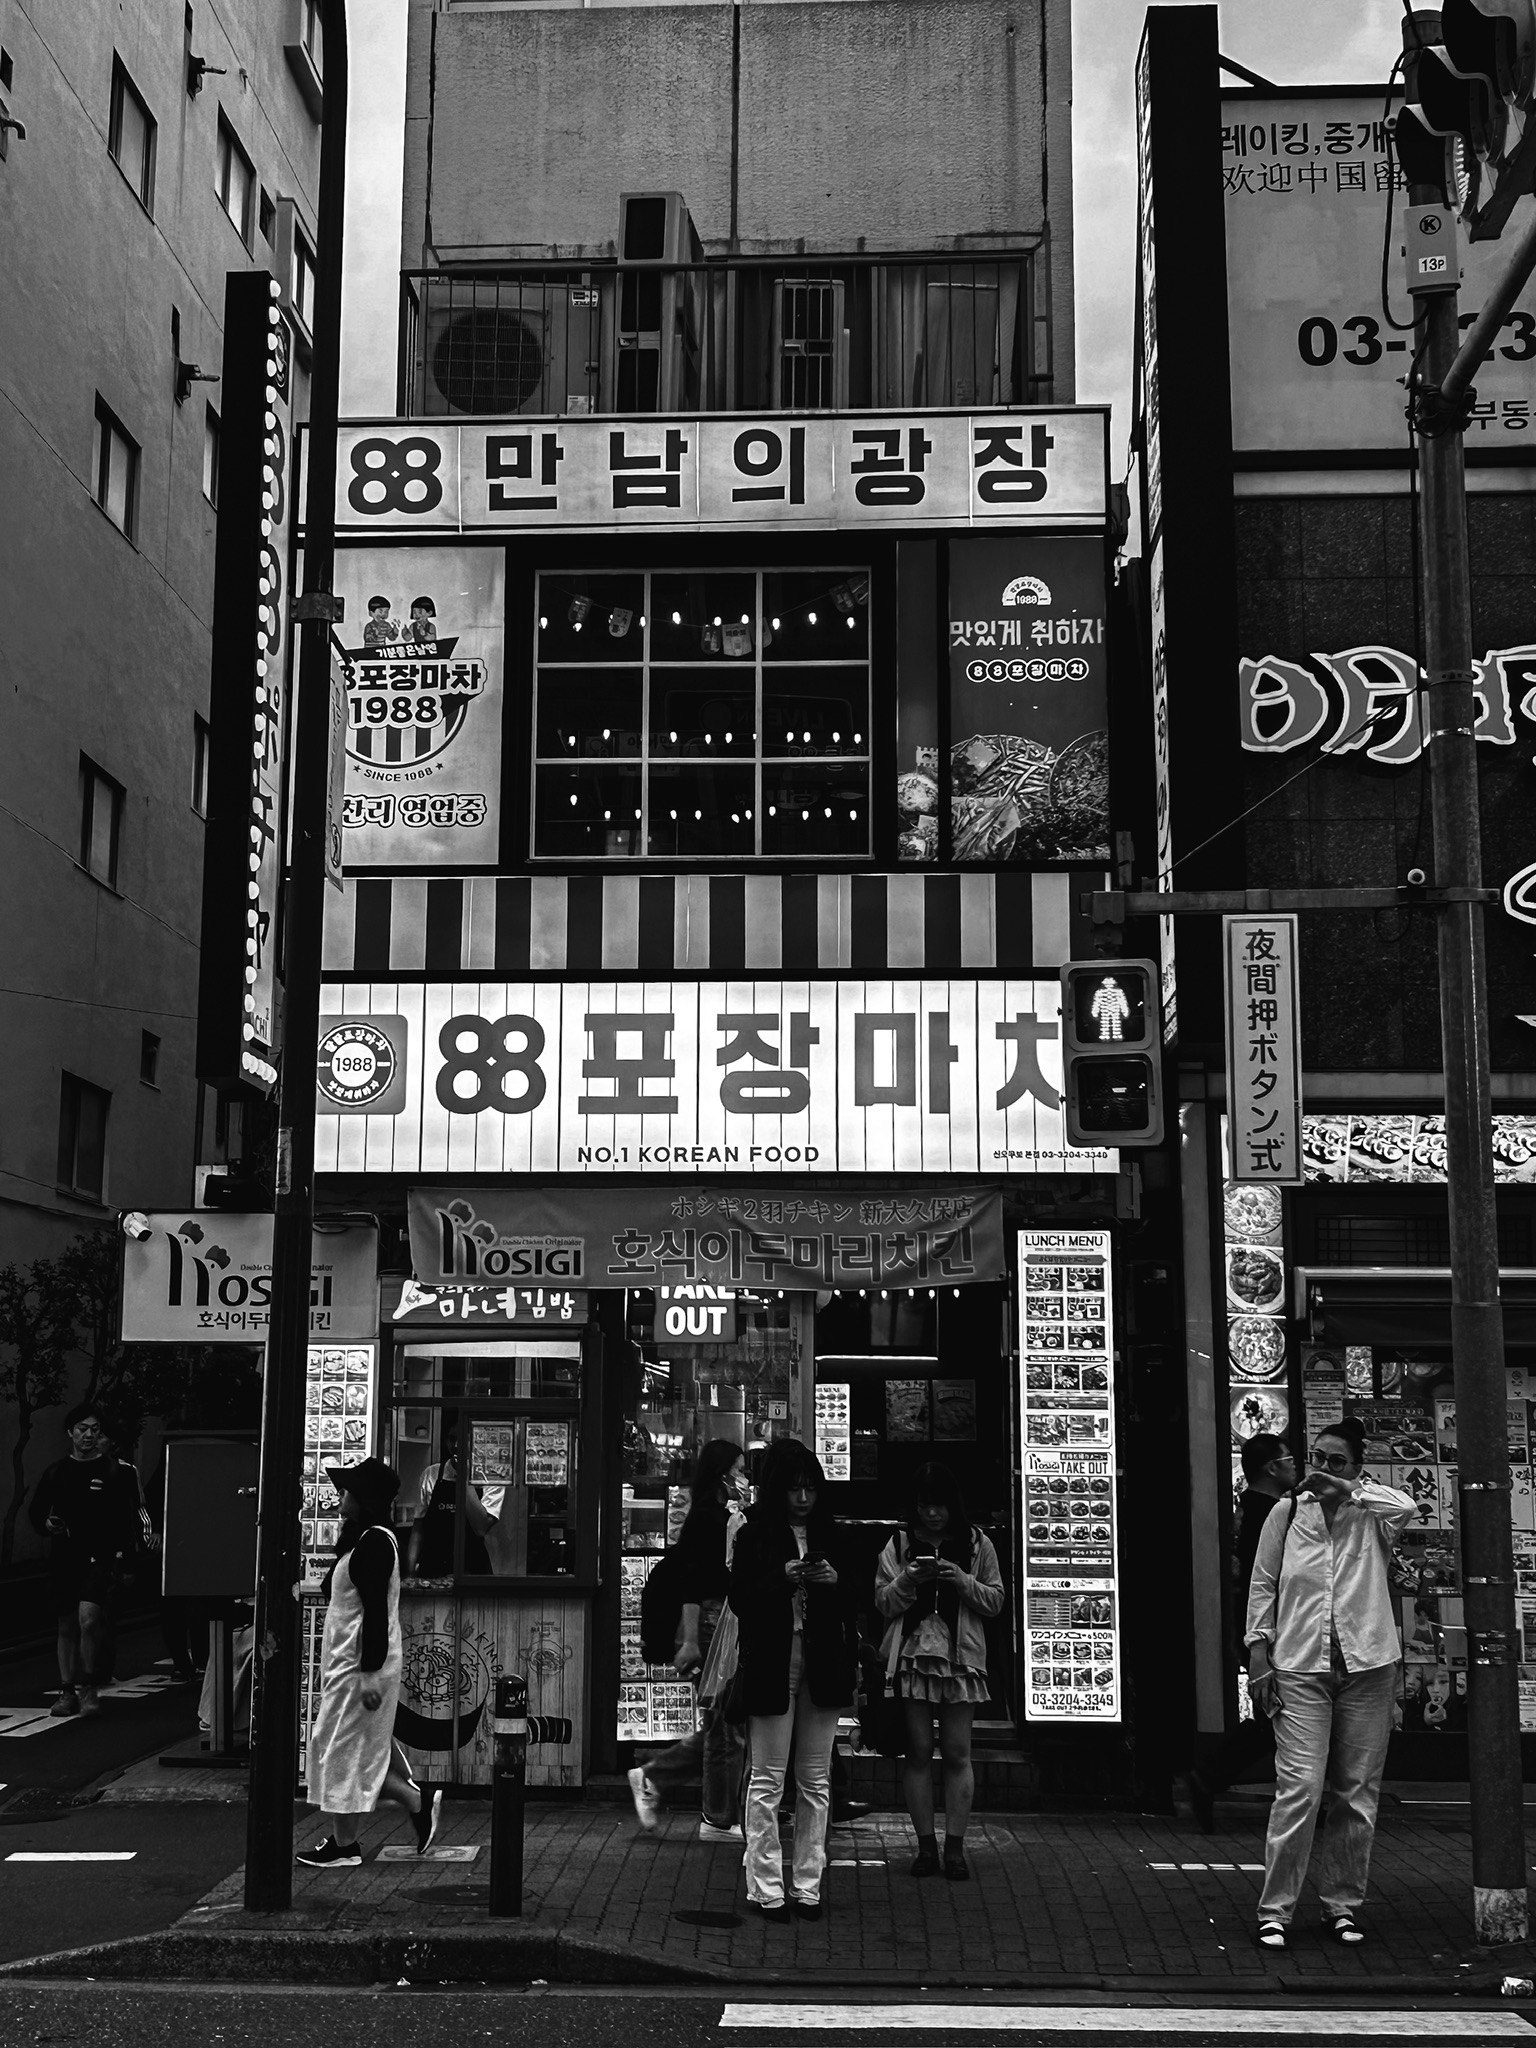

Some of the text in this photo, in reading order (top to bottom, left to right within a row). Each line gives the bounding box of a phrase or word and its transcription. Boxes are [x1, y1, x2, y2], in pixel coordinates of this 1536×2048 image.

[1421, 257, 1445, 271] 13P
[1467, 400, 1536, 430] 부동
[347, 437, 443, 514] 88
[950, 619, 1104, 646] 맛있게 취하자
[350, 696, 438, 724] 1988
[364, 768, 401, 782] SINCE
[403, 798, 482, 824] 영업중
[1246, 928, 1282, 1172] 夜間押ボタン式
[335, 1057, 373, 1072] 1988
[436, 1013, 547, 1115] 88
[577, 1146, 819, 1163] NO.1 KOREAN FOOD
[859, 1195, 975, 1225] 新大久保店
[545, 1237, 582, 1247] Originator
[1025, 1235, 1103, 1247] LUNCH MENU
[607, 1228, 976, 1284] 호식이두마리치킨
[665, 1305, 728, 1336] OUT
[1061, 1461, 1108, 1475] TAKE OUT
[1405, 1466, 1440, 1527] 餃子
[1032, 1693, 1113, 1707] 03-3204-3349
